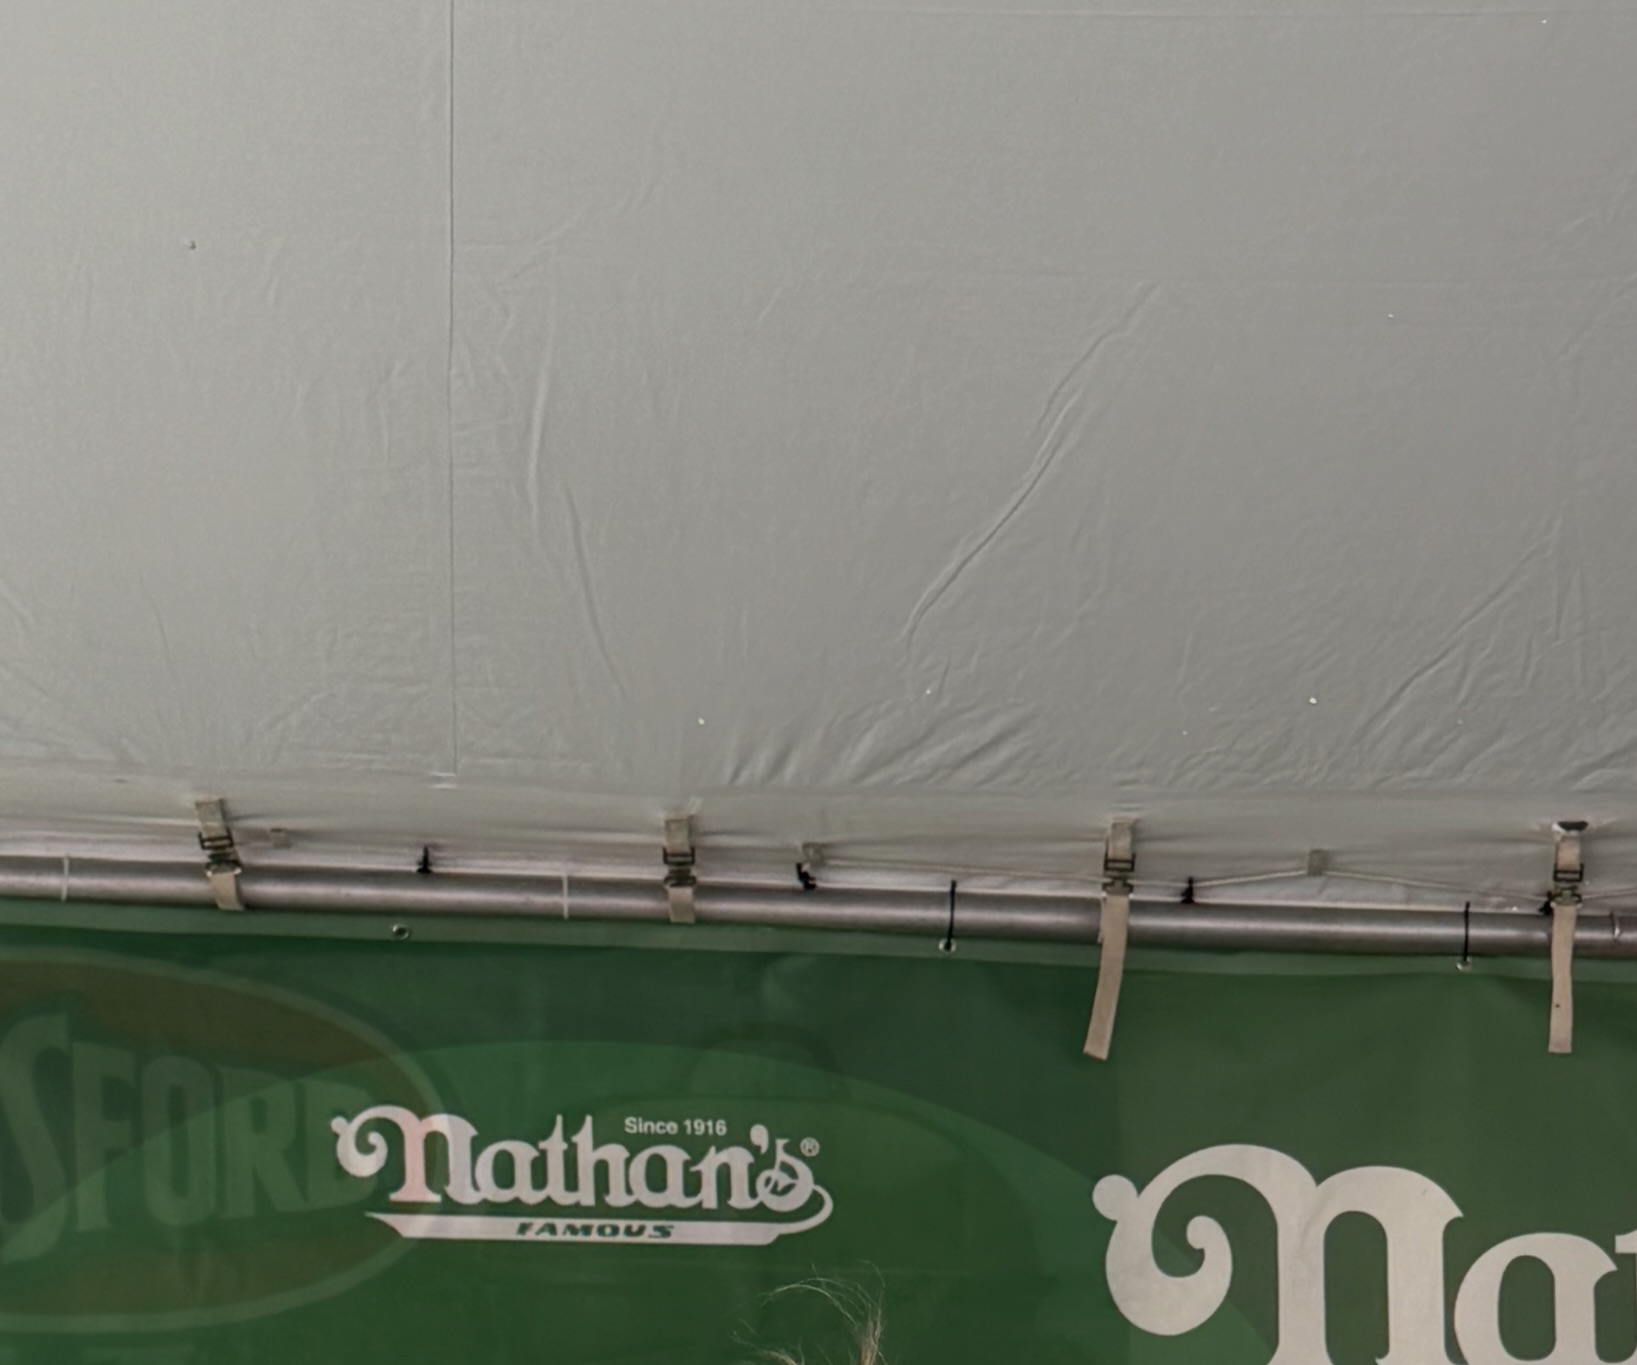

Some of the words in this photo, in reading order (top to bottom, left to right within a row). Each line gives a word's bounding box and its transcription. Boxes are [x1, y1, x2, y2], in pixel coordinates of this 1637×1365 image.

[624, 1116, 678, 1136] Since
[684, 1119, 727, 1138] 1916
[330, 1105, 815, 1213] Nathan's
[516, 1221, 675, 1240] FAMOUS
